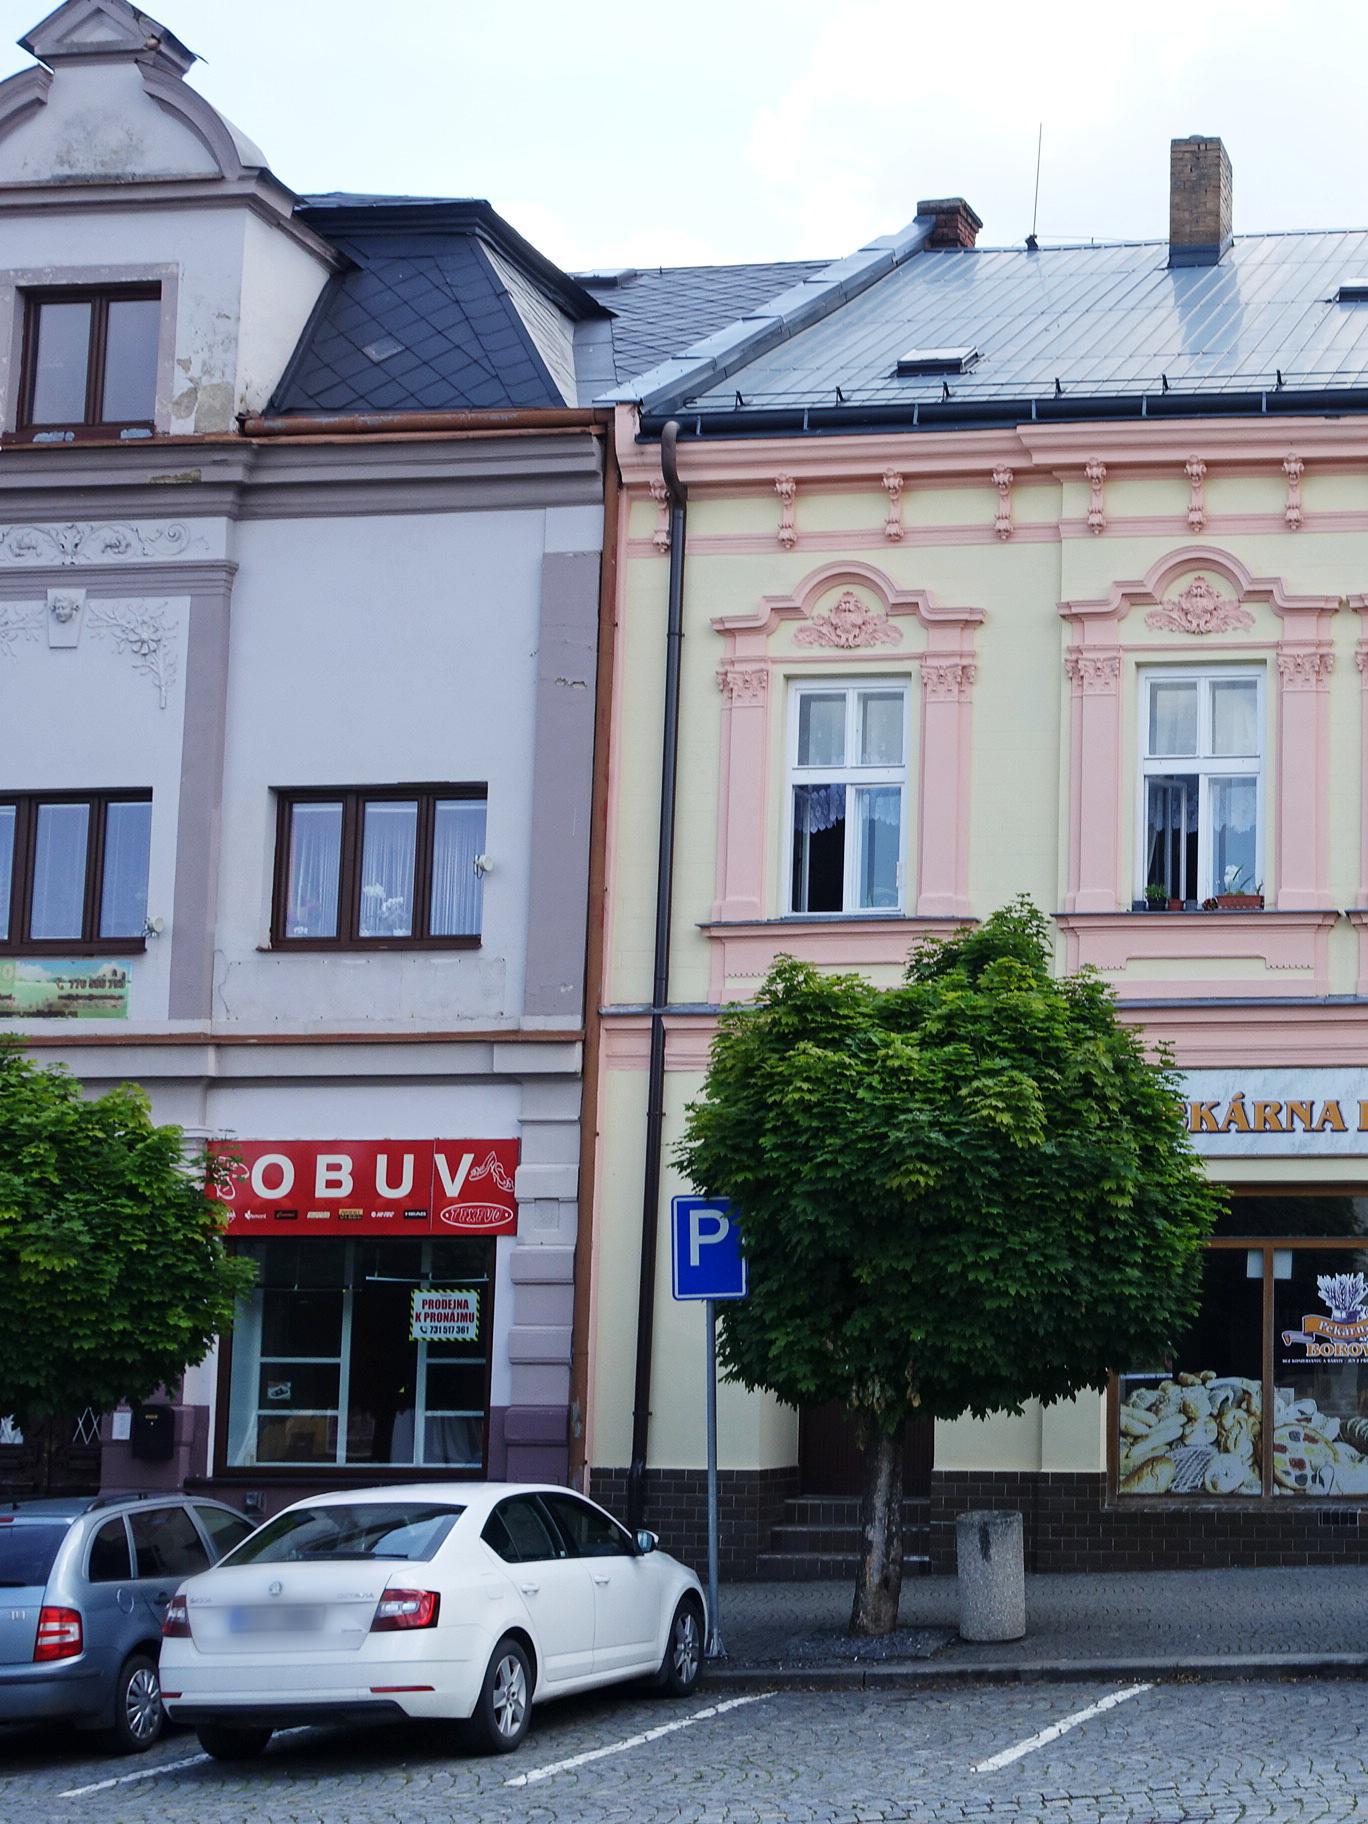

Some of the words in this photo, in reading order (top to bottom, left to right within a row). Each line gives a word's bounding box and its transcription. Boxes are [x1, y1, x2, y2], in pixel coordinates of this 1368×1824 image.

[1175, 1092, 1348, 1133] KÁRNA
[251, 1153, 475, 1200] OBUV
[689, 1208, 730, 1267] P
[415, 1312, 422, 1323] K
[423, 1310, 475, 1323] PRONÁJMU
[421, 1299, 470, 1310] PRODEJNA
[429, 1325, 441, 1334] 731
